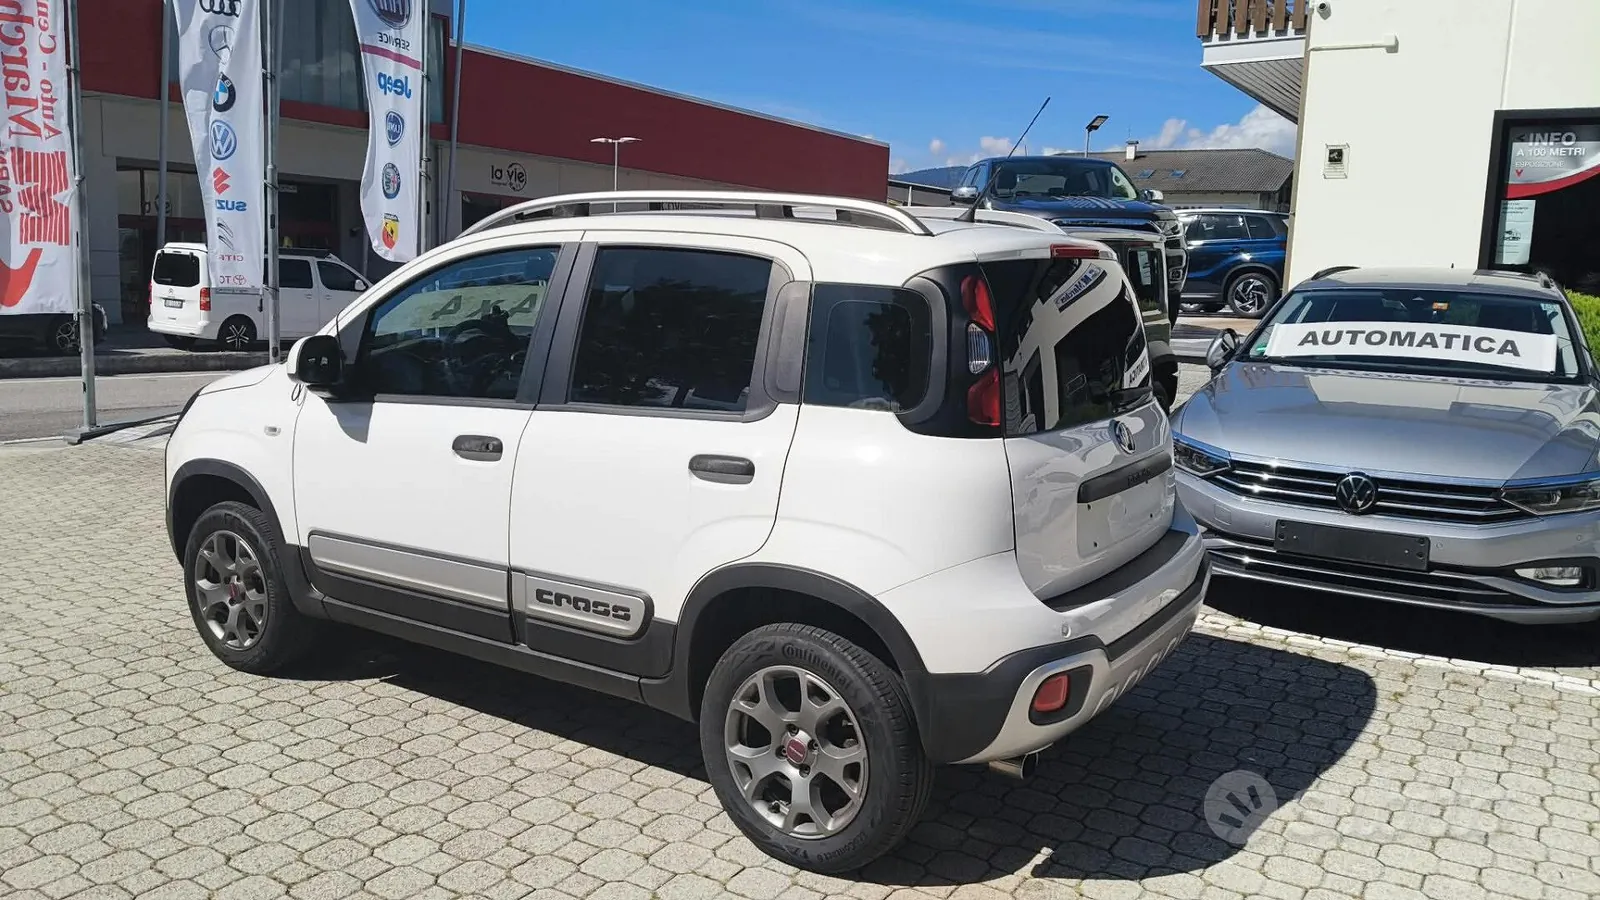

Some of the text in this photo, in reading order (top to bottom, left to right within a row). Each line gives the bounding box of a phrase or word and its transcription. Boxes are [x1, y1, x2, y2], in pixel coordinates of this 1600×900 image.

[1527, 131, 1577, 147] INFO
[1516, 147, 1586, 157] A 100 METRI
[491, 164, 525, 183] la vie
[1297, 329, 1522, 358] AUTOMATICA
[781, 642, 854, 690] Continental
